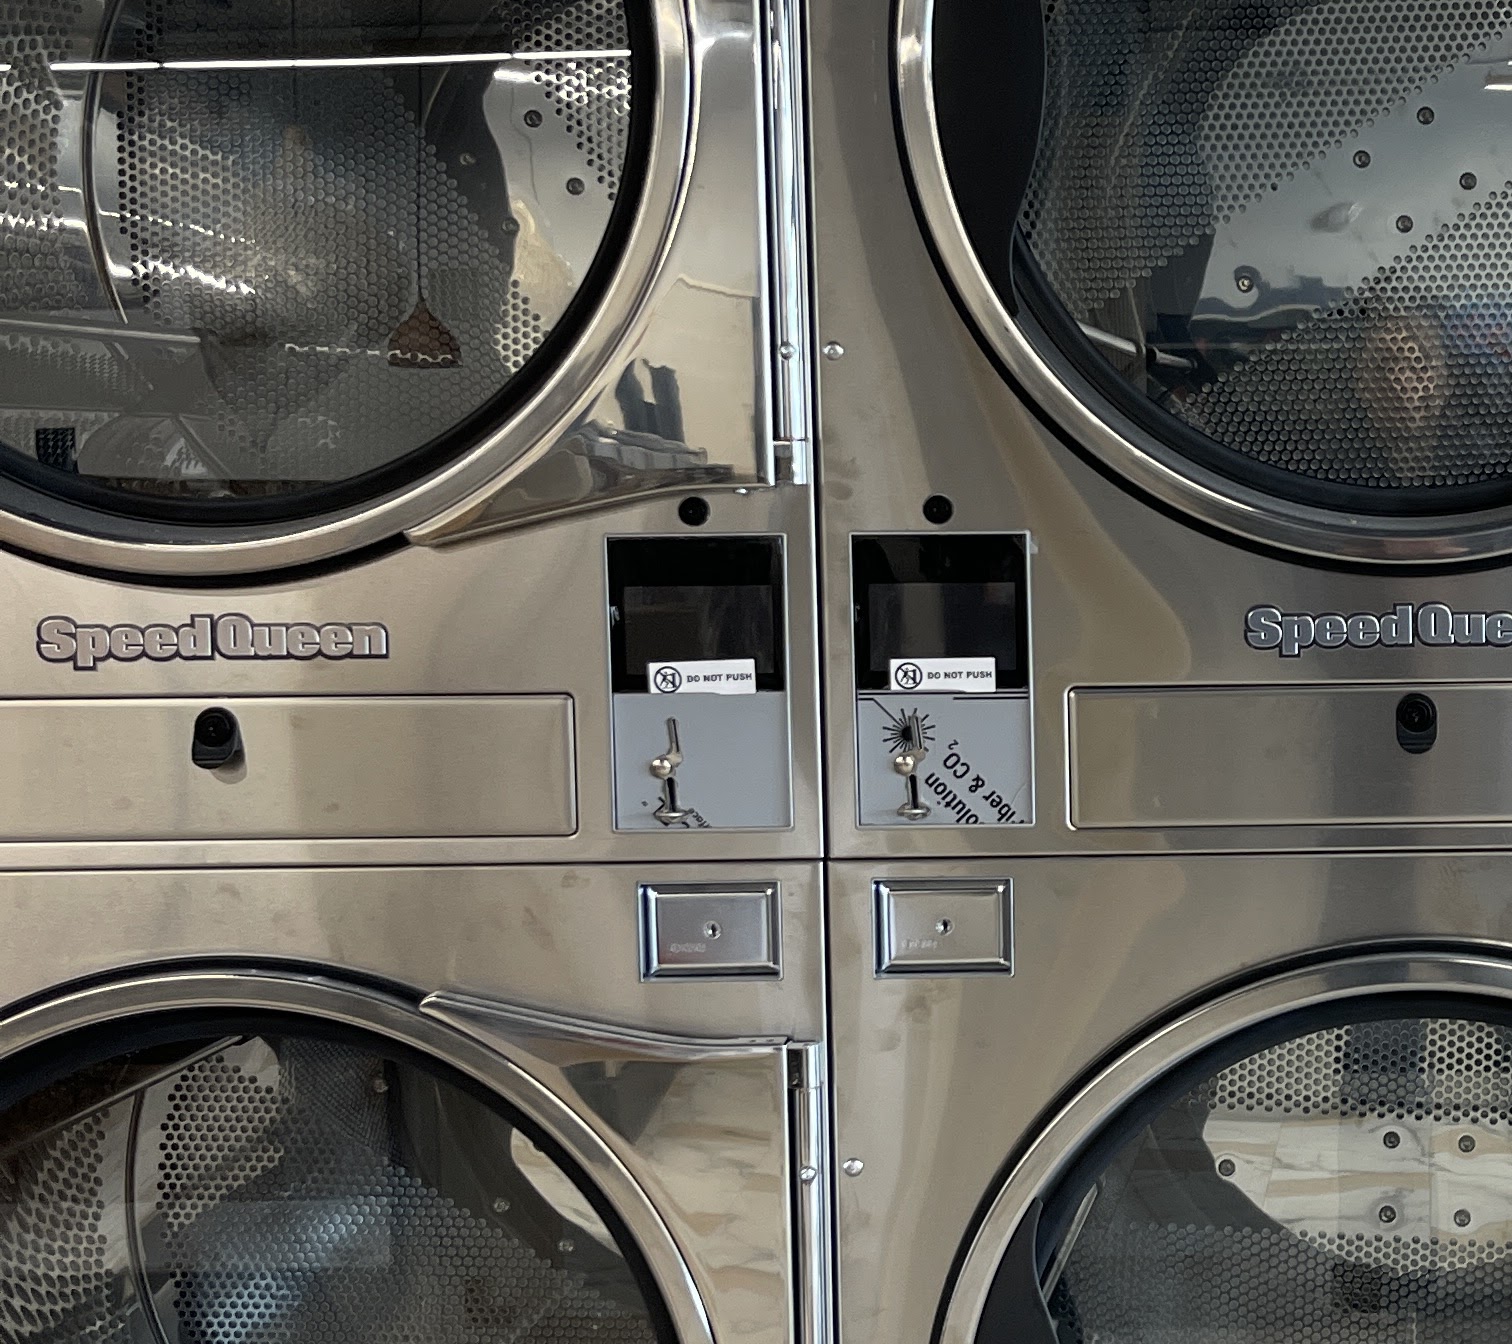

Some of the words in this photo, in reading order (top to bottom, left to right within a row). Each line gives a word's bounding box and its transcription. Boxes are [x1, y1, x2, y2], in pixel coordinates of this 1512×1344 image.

[36, 613, 214, 671] Speed
[214, 612, 390, 659] Queen
[1244, 603, 1415, 658] Speed
[686, 674, 701, 683] DO
[703, 673, 723, 682] NOT
[726, 672, 752, 681] PUSH
[927, 671, 941, 679] DO
[943, 671, 963, 679] NOT
[966, 670, 992, 679] PUSH
[924, 772, 984, 824] olution
[968, 773, 986, 794] &
[982, 789, 1024, 824] iber
